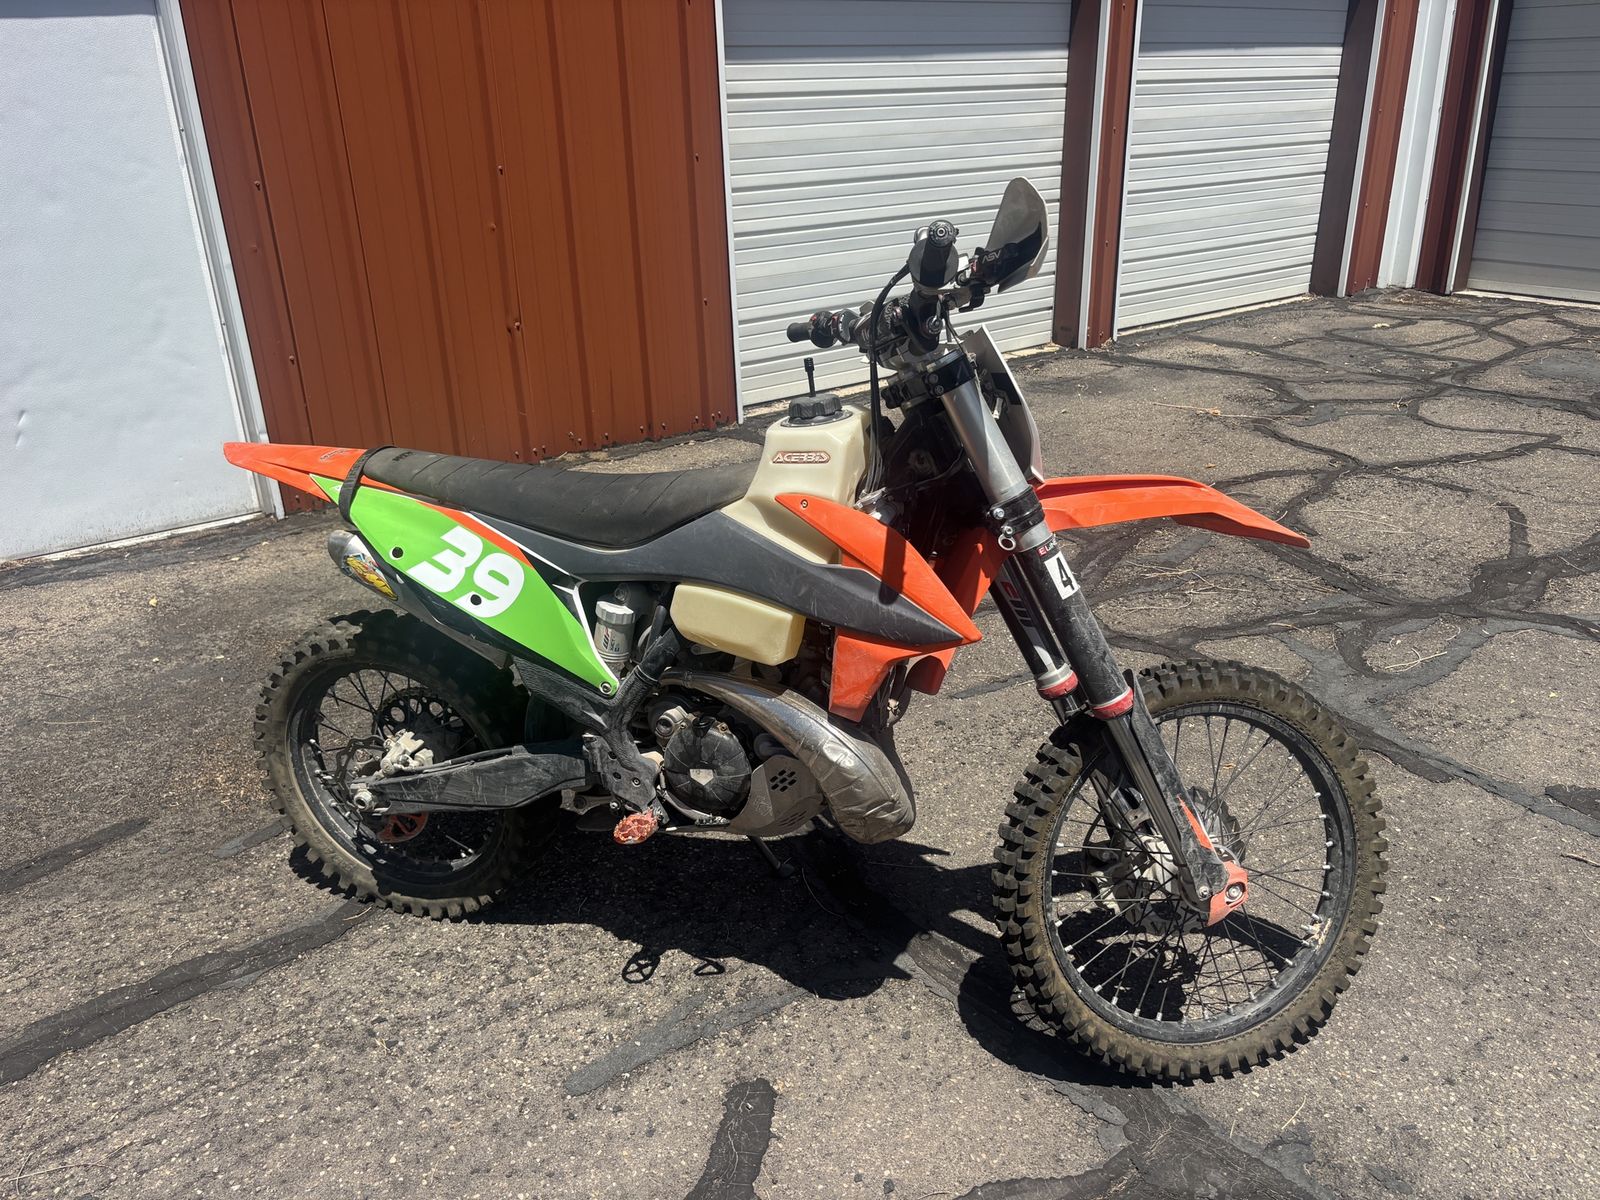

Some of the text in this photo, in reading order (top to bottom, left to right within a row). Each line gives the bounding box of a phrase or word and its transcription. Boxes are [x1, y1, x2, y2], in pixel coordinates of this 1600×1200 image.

[982, 249, 1001, 264] ASV
[407, 526, 525, 618] 39
[1056, 557, 1075, 591] 4
